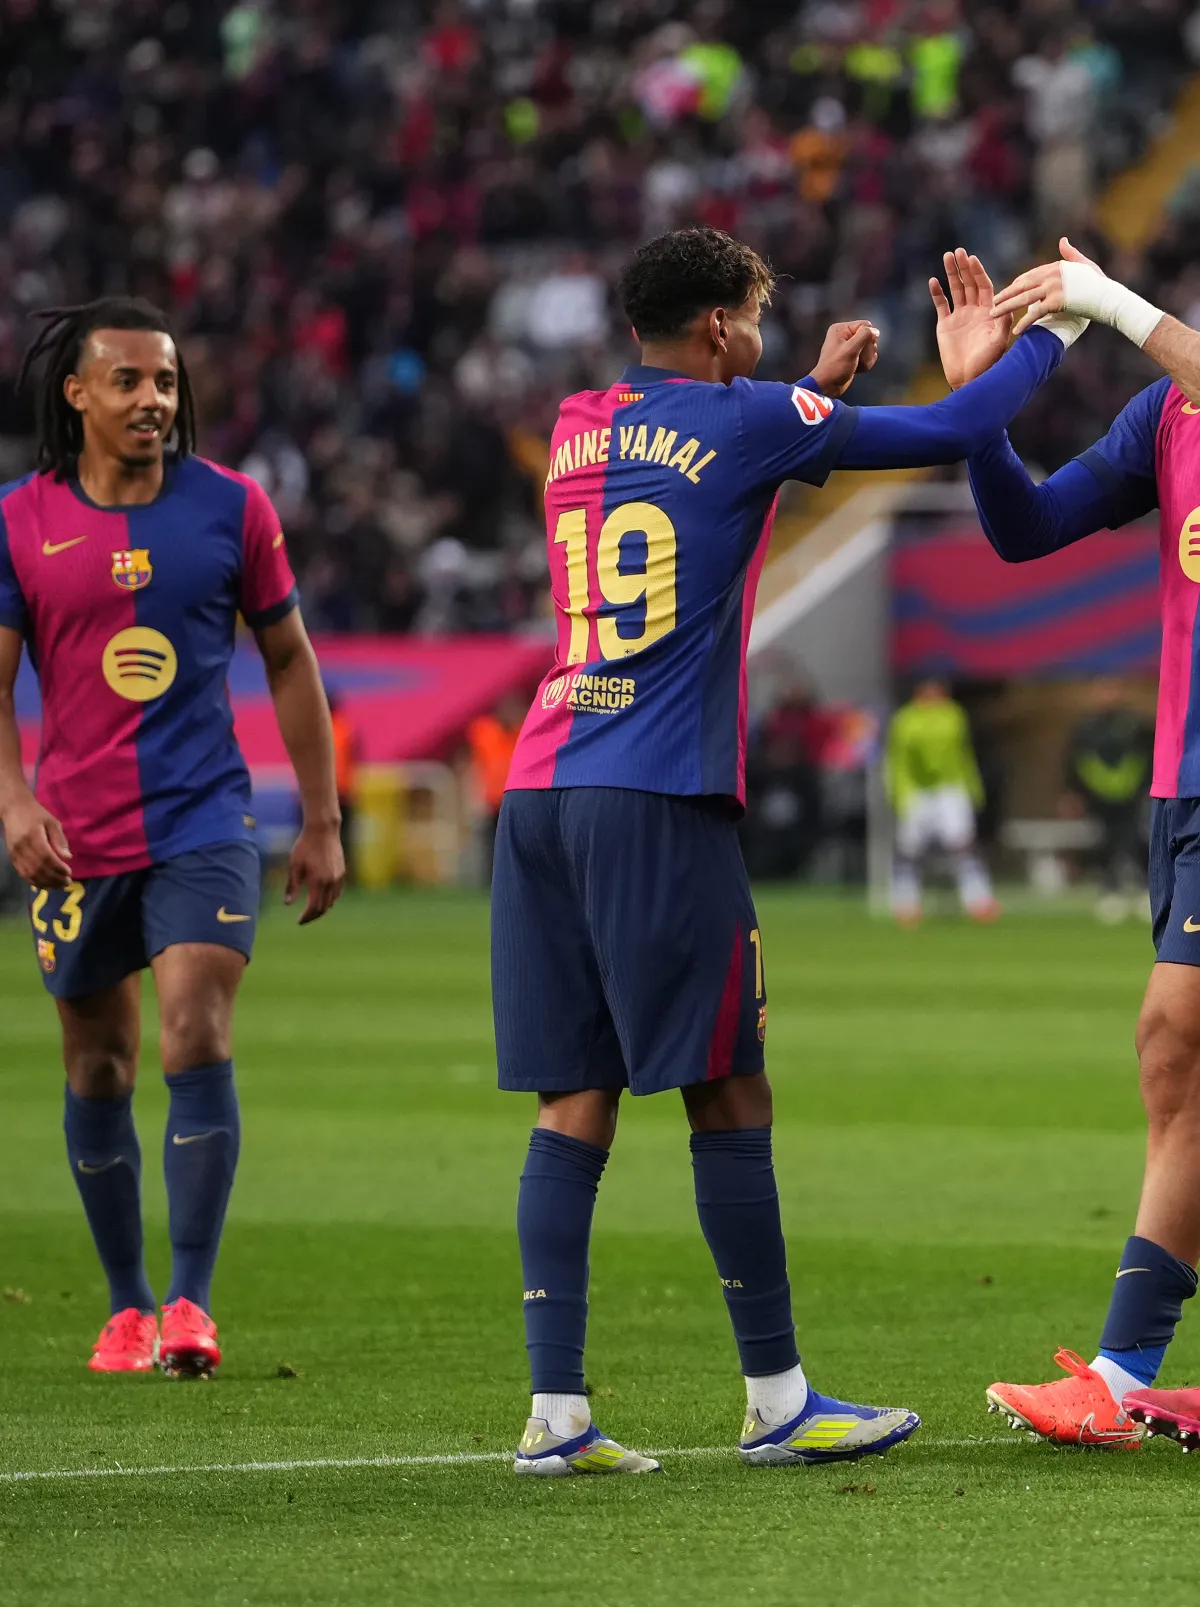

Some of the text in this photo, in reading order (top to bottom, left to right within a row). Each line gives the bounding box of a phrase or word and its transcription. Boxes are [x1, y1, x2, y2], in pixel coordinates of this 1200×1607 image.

[619, 425, 717, 484] YAMAL
[554, 502, 677, 666] 19
[571, 674, 635, 694] UNHCR
[31, 881, 86, 942] 23
